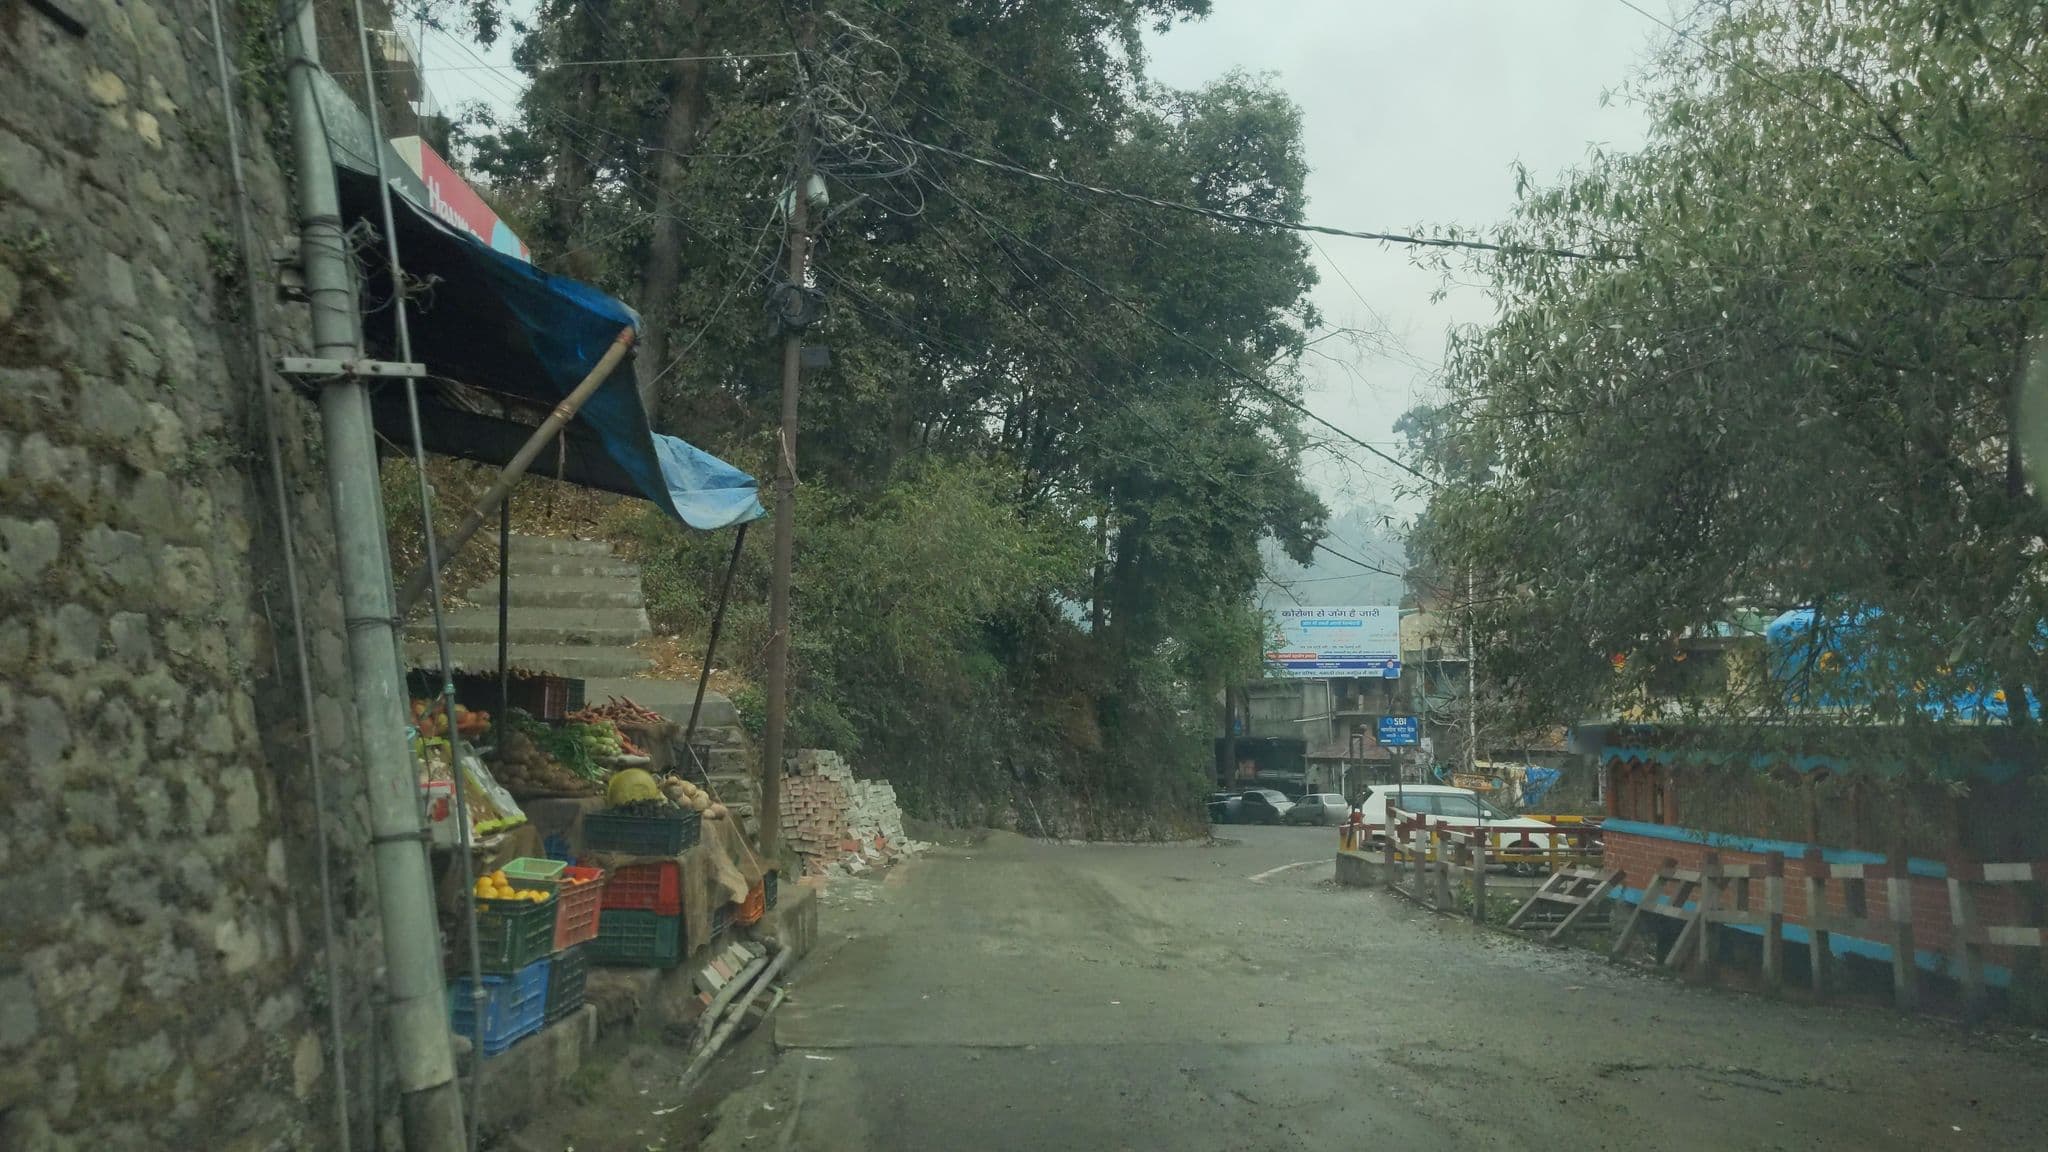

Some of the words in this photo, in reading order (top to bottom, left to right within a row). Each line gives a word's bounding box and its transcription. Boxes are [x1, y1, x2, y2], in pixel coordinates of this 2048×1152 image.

[1281, 608, 1313, 617] कोरोना
[1317, 608, 1325, 617] से
[1328, 608, 1346, 617] जंग
[1349, 608, 1356, 617] है
[1358, 608, 1380, 617] जारी
[1394, 717, 1407, 725] SBI
